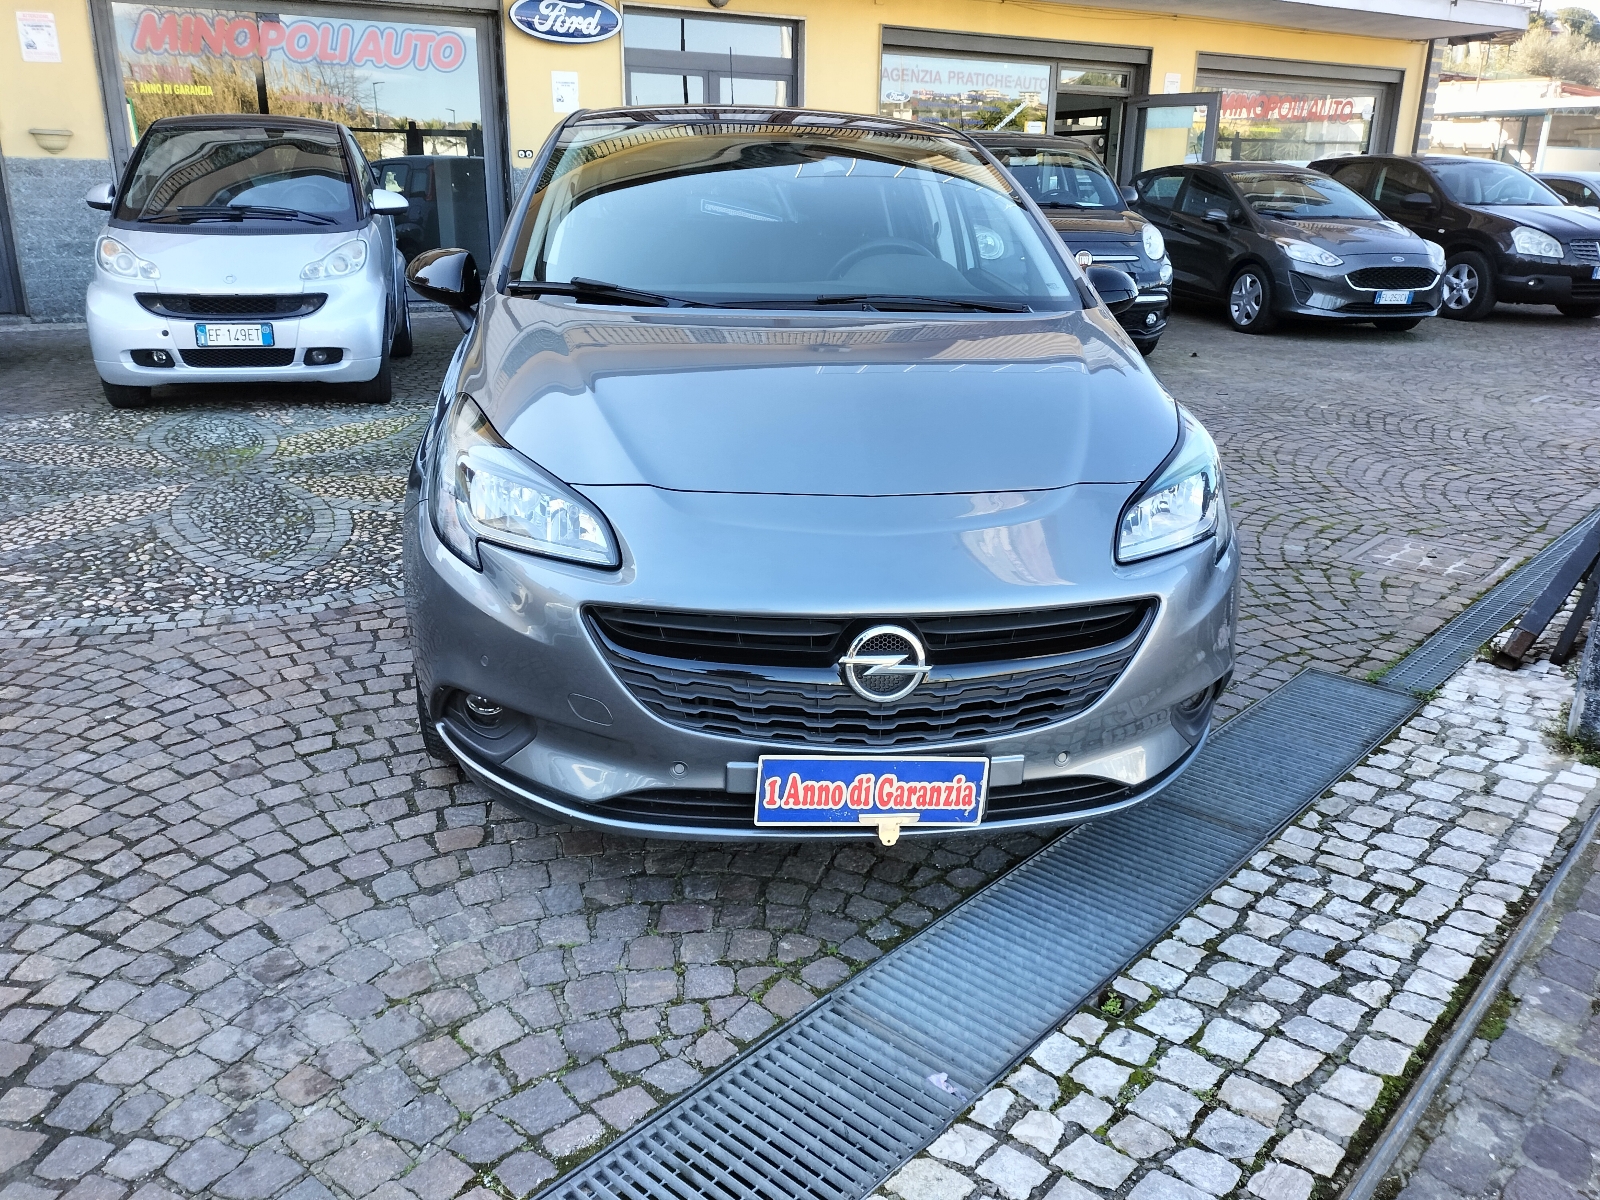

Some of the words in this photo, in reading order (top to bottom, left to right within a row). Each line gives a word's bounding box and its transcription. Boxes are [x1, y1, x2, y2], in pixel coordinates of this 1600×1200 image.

[534, 0, 602, 36] Ford
[133, 11, 351, 63] MINOPOLI
[353, 28, 464, 70] AUTO
[140, 84, 162, 94] ANNO
[164, 84, 172, 94] DI
[174, 85, 213, 96] GARANZIA
[882, 67, 943, 84] AGENZIA
[947, 70, 1013, 89] PRATICHE
[1013, 75, 1049, 91] AUTO
[1306, 97, 1354, 122] AUTO
[765, 778, 779, 806] 1
[785, 774, 846, 808] Anno
[850, 776, 872, 808] di
[876, 775, 976, 808] Garanzia
